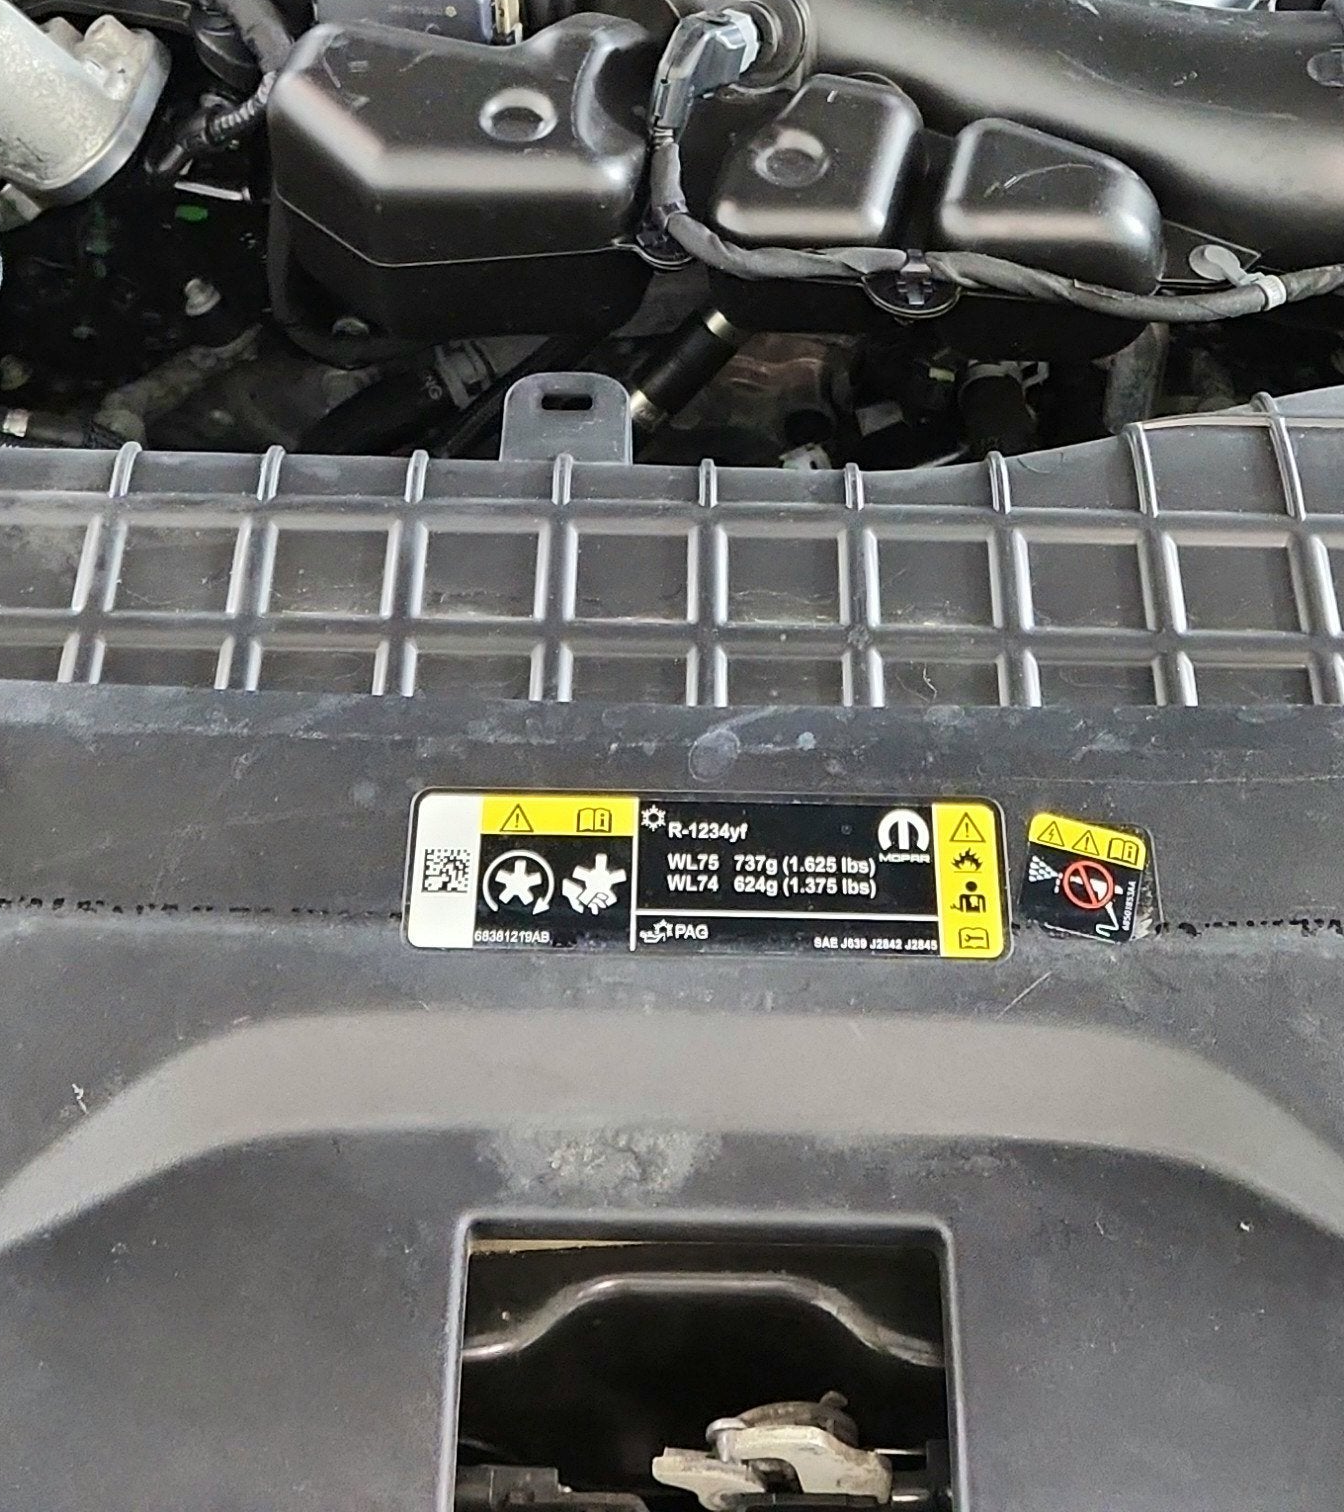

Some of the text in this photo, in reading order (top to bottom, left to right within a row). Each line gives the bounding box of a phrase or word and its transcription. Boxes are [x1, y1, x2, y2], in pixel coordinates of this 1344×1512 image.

[667, 821, 748, 842] R-1234yf
[667, 853, 876, 878] WL75 737g (1.625 lbs)
[878, 853, 931, 864] MOPAR
[667, 874, 877, 899] WL74 624g (1.375 lbs)
[674, 924, 709, 939] PAG
[813, 937, 838, 949] SAE
